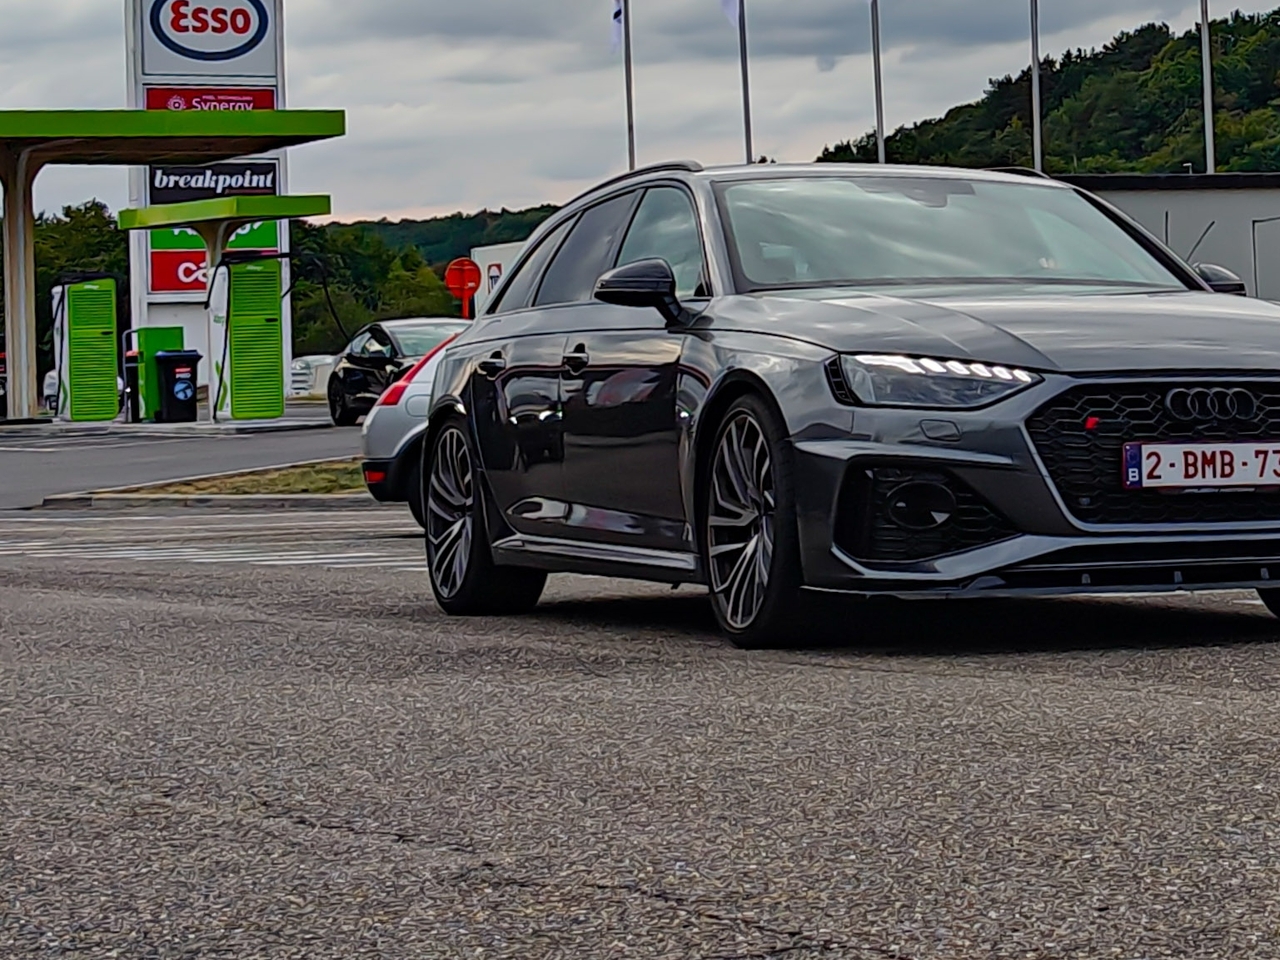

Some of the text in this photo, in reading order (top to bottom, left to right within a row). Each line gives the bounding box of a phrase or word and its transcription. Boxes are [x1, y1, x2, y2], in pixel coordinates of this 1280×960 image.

[170, 0, 251, 34] Esso
[154, 170, 274, 193] breakpoint
[1128, 468, 1139, 481] B
